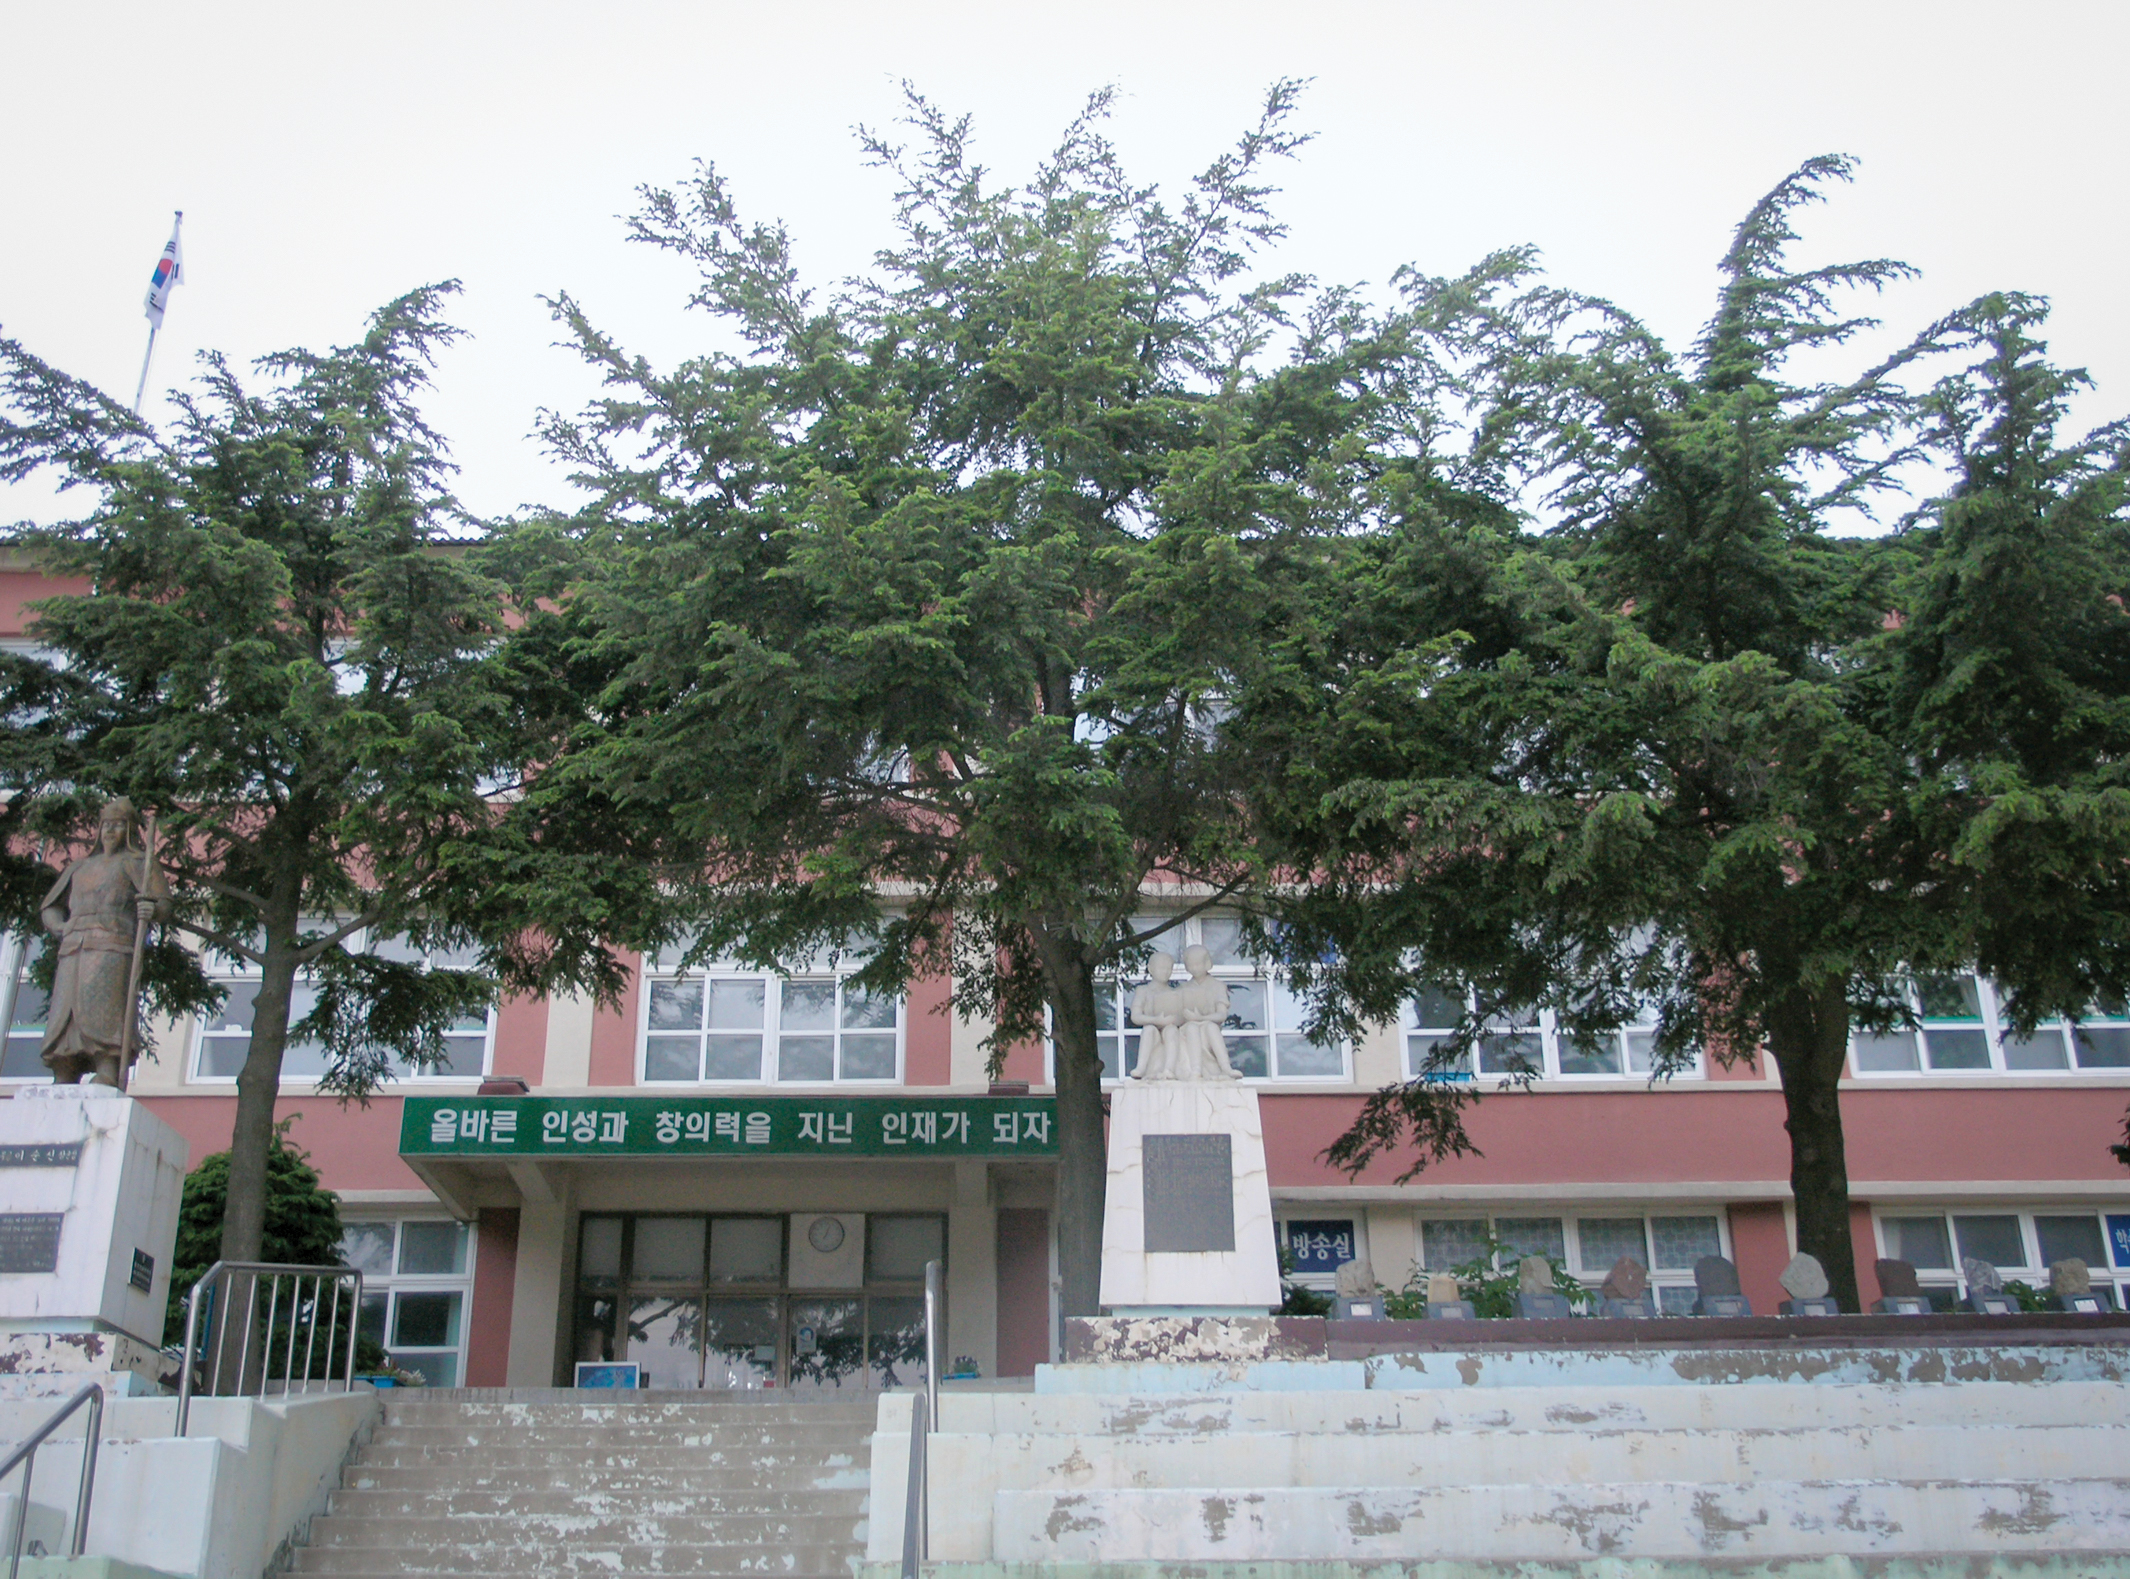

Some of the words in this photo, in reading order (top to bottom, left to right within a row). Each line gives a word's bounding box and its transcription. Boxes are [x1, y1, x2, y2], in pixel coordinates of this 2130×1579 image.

[431, 1108, 518, 1143] 올바른
[542, 1110, 629, 1143] 인성과
[655, 1111, 772, 1144] 창의력을
[797, 1111, 853, 1144] 지닌
[882, 1111, 971, 1144] 인재가
[992, 1111, 1051, 1144] 되자
[1292, 1231, 1351, 1260] 방송실
[2115, 1228, 2130, 1255] 학
